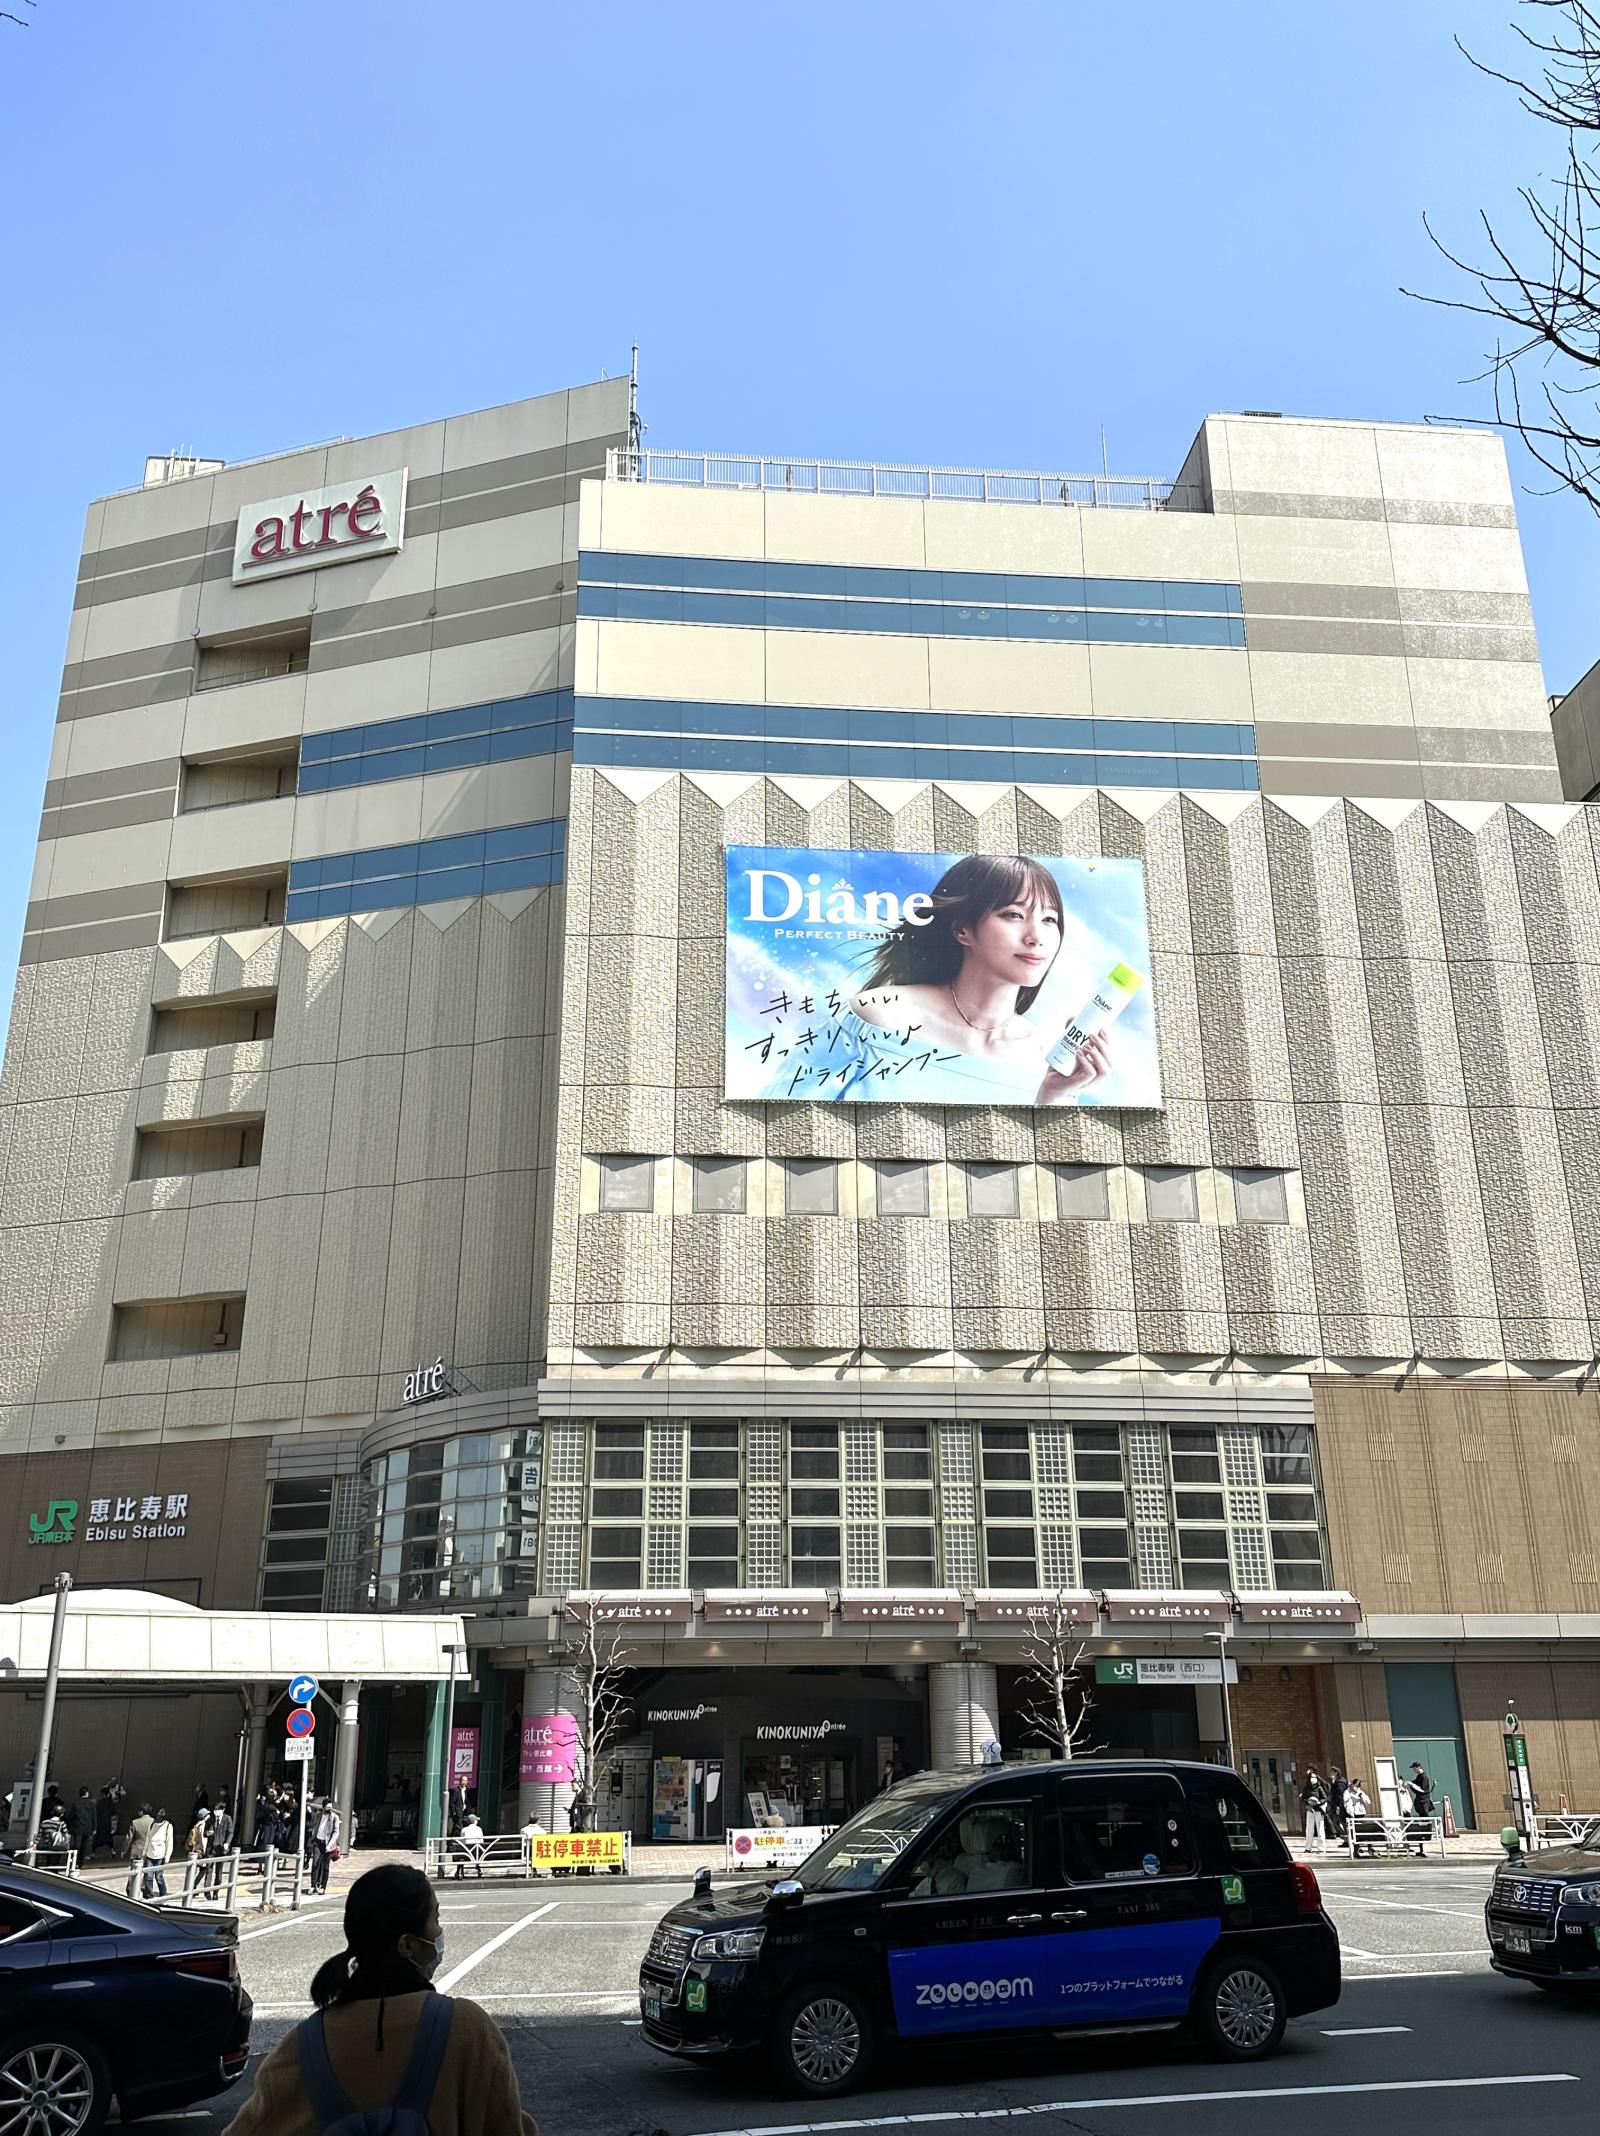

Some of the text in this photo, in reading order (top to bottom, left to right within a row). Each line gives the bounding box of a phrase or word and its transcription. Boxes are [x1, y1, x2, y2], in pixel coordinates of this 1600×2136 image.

[251, 485, 383, 559] atré
[743, 870, 935, 926] Diane
[774, 928, 906, 942] PERFECT BEAUTY
[1066, 1025, 1090, 1046] DRY
[788, 1048, 962, 1097] ドライシャンプー
[403, 1356, 444, 1401] atré
[29, 1500, 79, 1533] JR
[88, 1494, 189, 1524] 恵比寿駅
[85, 1523, 186, 1542] Ebisu Station
[618, 1605, 641, 1617] atré
[756, 1605, 779, 1617] atré
[892, 1605, 915, 1617] atré
[1159, 1605, 1182, 1617] atré
[1290, 1605, 1313, 1617] atré
[1113, 1662, 1134, 1676] JR
[647, 1709, 700, 1722] KINOKUNIYA
[524, 1725, 553, 1743] atré
[756, 1725, 826, 1740] KINOKUNIYA
[536, 1838, 619, 1859] 駐停車禁止
[1565, 1925, 1583, 1935] km
[1060, 1975, 1184, 1994] 1つのプラットフォームでつながる
